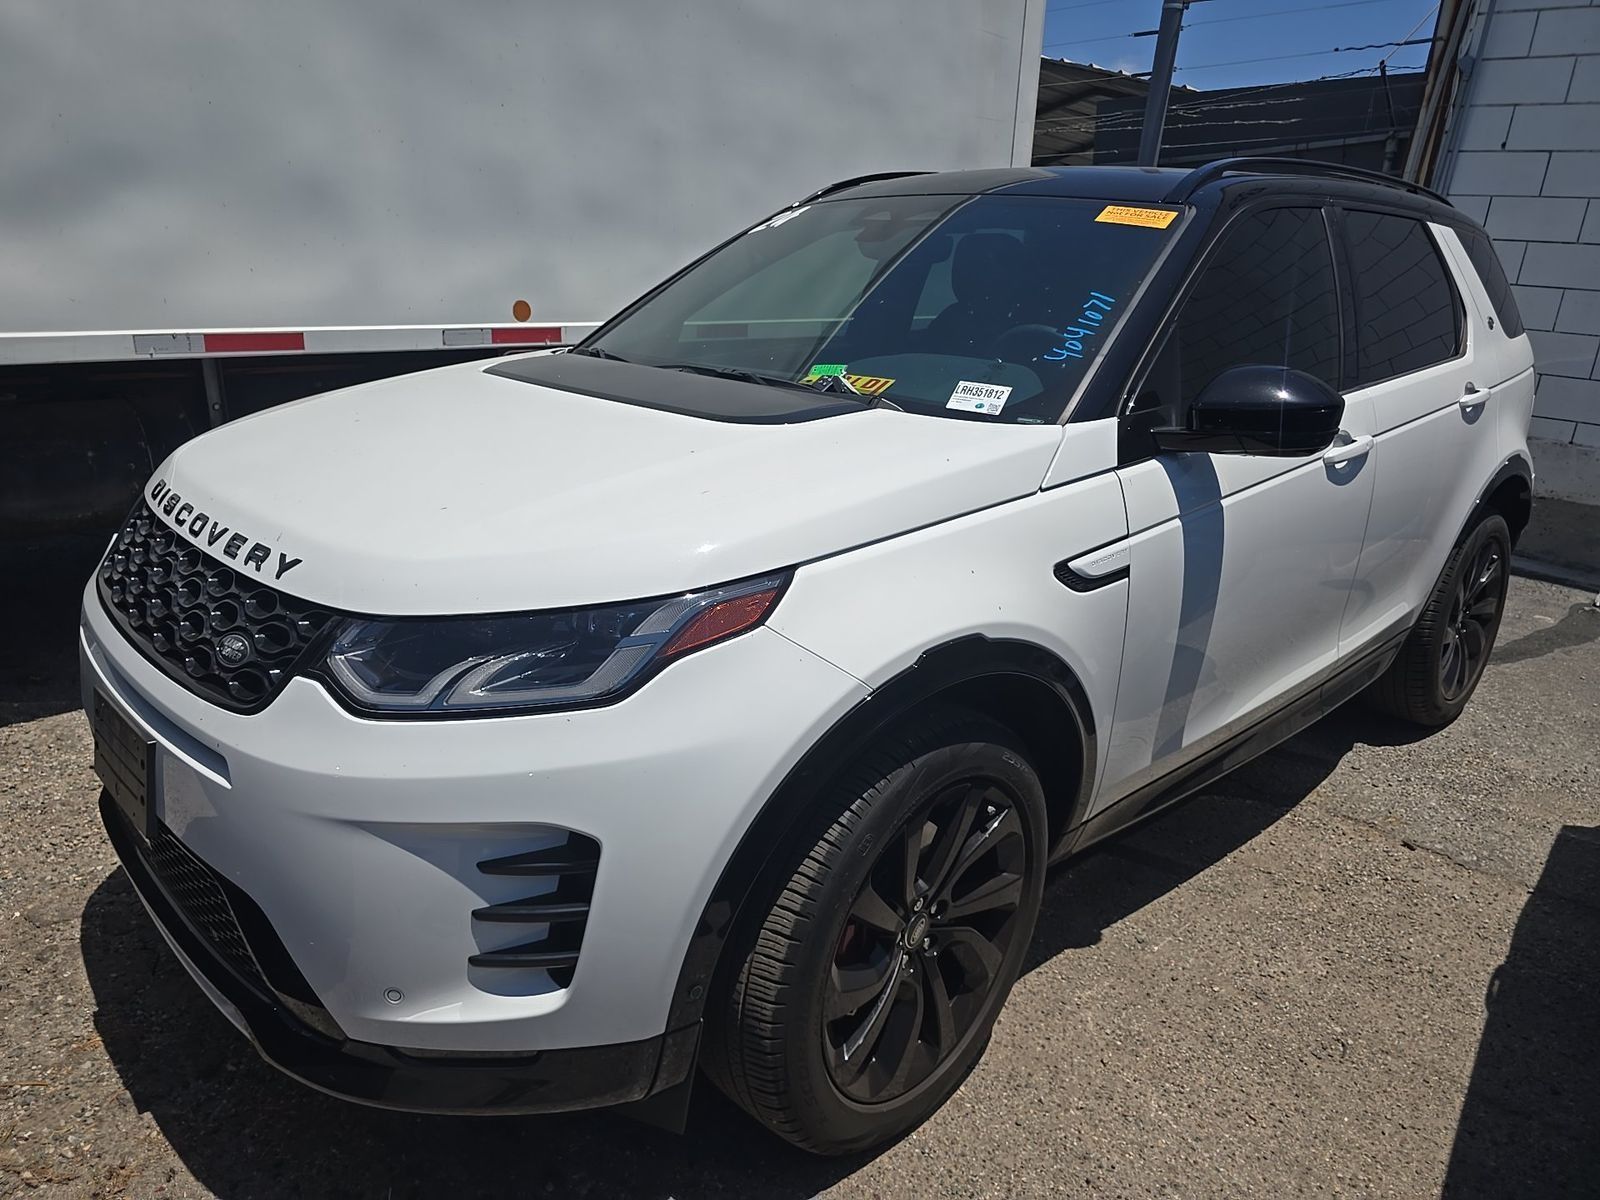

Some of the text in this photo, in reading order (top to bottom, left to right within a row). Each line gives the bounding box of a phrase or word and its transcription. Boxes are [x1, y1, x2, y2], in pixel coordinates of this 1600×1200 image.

[1043, 291, 1116, 361] 4041071
[954, 384, 1005, 400] LRH351812
[151, 478, 304, 580] DISCOVERY
